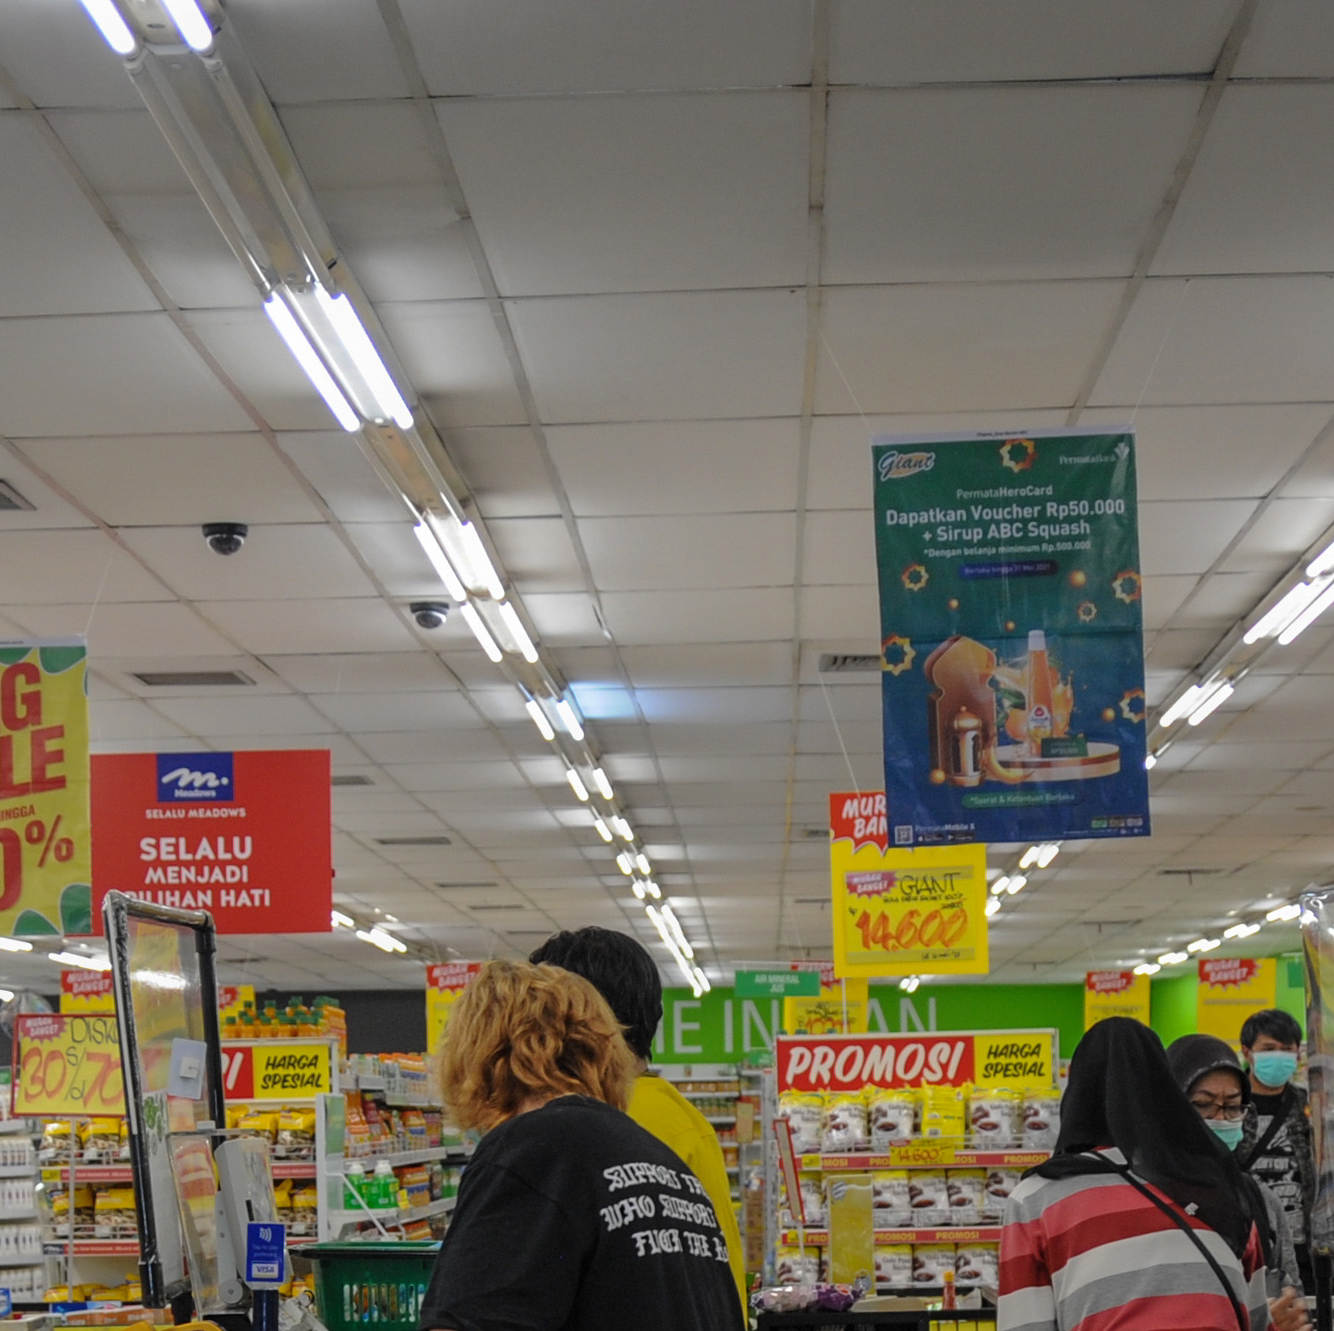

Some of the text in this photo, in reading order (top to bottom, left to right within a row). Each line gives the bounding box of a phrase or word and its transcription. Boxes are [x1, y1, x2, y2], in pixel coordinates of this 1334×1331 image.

[878, 450, 935, 482] Giant
[957, 484, 1053, 499] PermataHeroCard
[886, 499, 1125, 527] Dapatkan Voucher Rp50.000
[922, 519, 1091, 543] + Sirup ABC Squash
[964, 545, 997, 558] belanja
[998, 543, 1040, 554] minimum
[174, 788, 216, 798] Meadows
[145, 808, 246, 819] SELALU MEADOWS
[842, 795, 886, 817] MUR
[139, 836, 253, 861] SELALU
[144, 865, 249, 884] MENJADI
[900, 873, 961, 896] GIANT
[220, 888, 270, 908] HATI
[987, 1043, 1041, 1060] HARGA
[265, 1055, 319, 1070] HARGA
[786, 1042, 965, 1085] PROMOSI
[982, 1061, 1046, 1079] SPESIAL
[261, 1073, 323, 1089] SPESIAL
[1004, 1155, 1050, 1164] PROMOSI
[599, 1195, 655, 1232] WHO
[935, 1231, 979, 1240] PROMOSI
[256, 1265, 275, 1273] VISA
